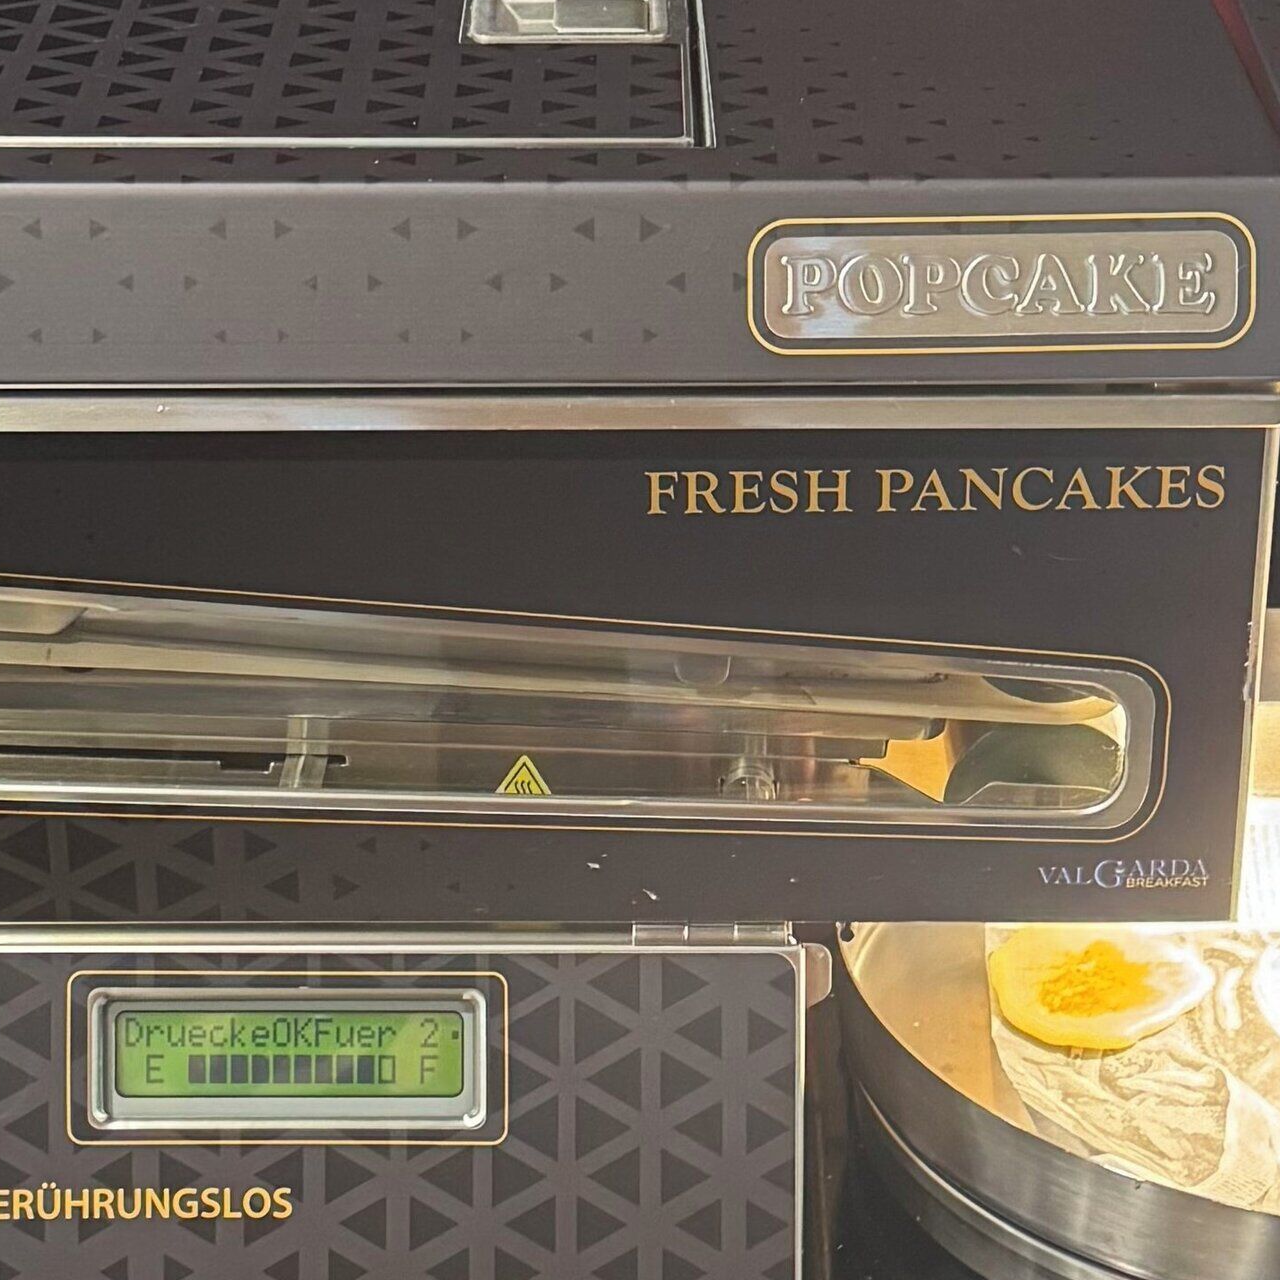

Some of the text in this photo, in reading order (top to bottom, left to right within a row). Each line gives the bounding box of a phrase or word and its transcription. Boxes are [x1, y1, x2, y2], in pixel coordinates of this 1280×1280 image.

[781, 252, 1216, 318] POPCAKE
[644, 463, 1227, 516] FRESH PANCAKES
[1125, 876, 1209, 888] BREAKFAST
[124, 1017, 439, 1048] DrueckeOKFuer 2
[145, 1054, 439, 1084] E F
